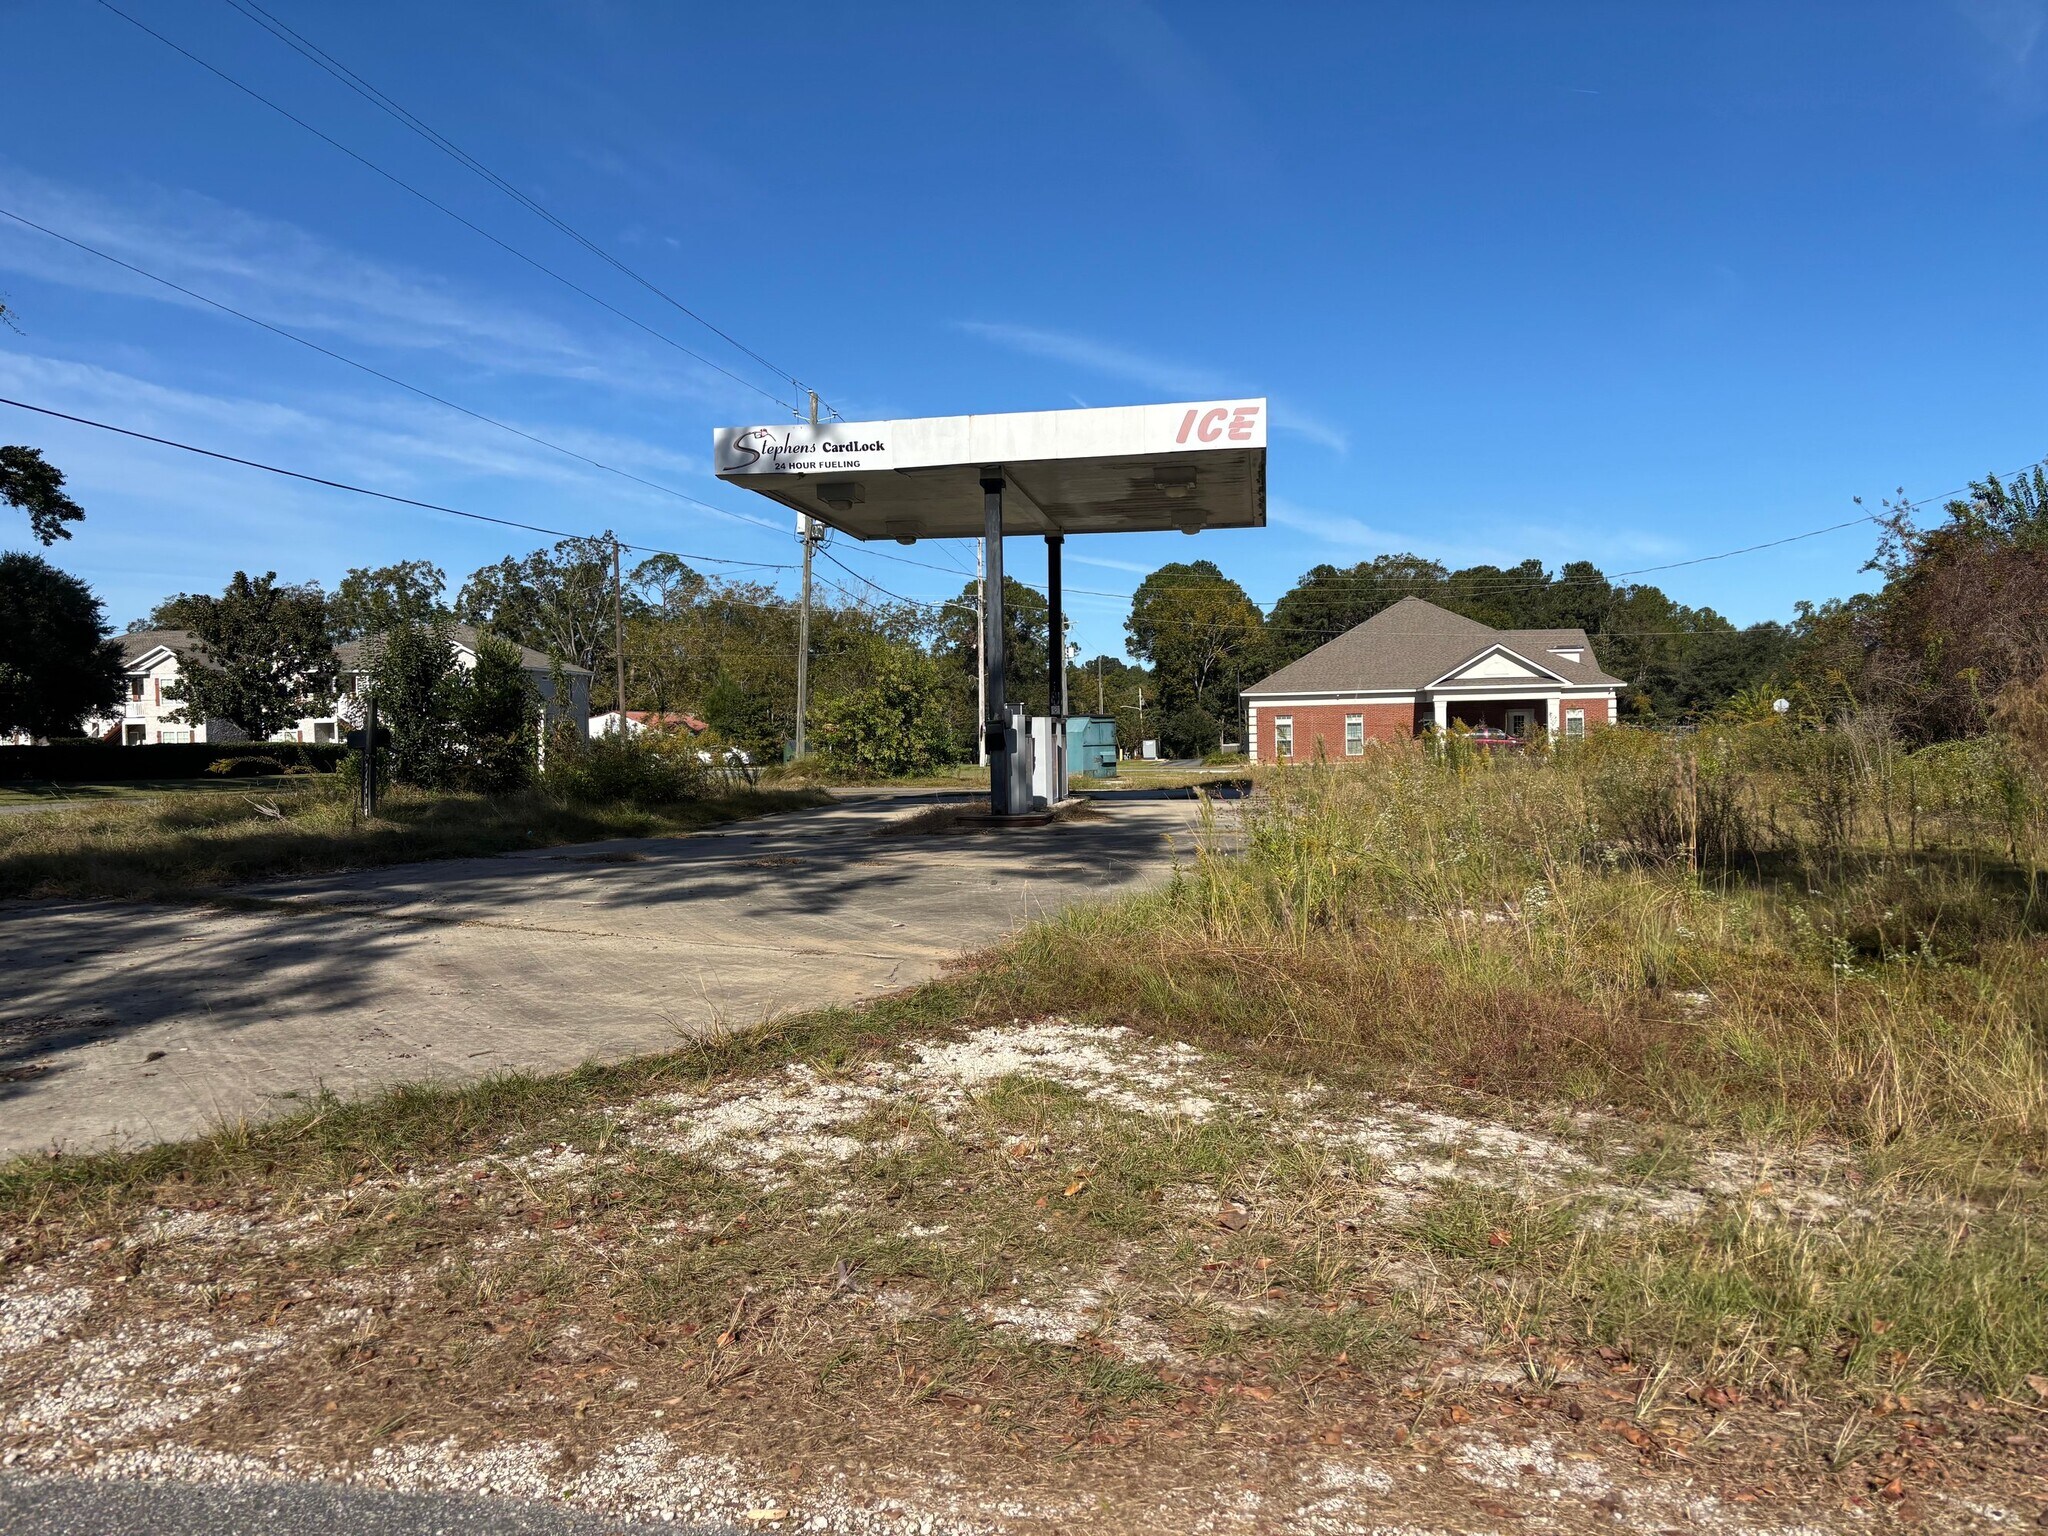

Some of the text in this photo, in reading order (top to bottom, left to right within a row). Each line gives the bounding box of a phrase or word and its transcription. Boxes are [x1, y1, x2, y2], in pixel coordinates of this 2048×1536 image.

[1176, 406, 1260, 444] ICE
[723, 430, 885, 471] Stephens CardLock
[774, 460, 861, 470] 24 HOUR FUELING
